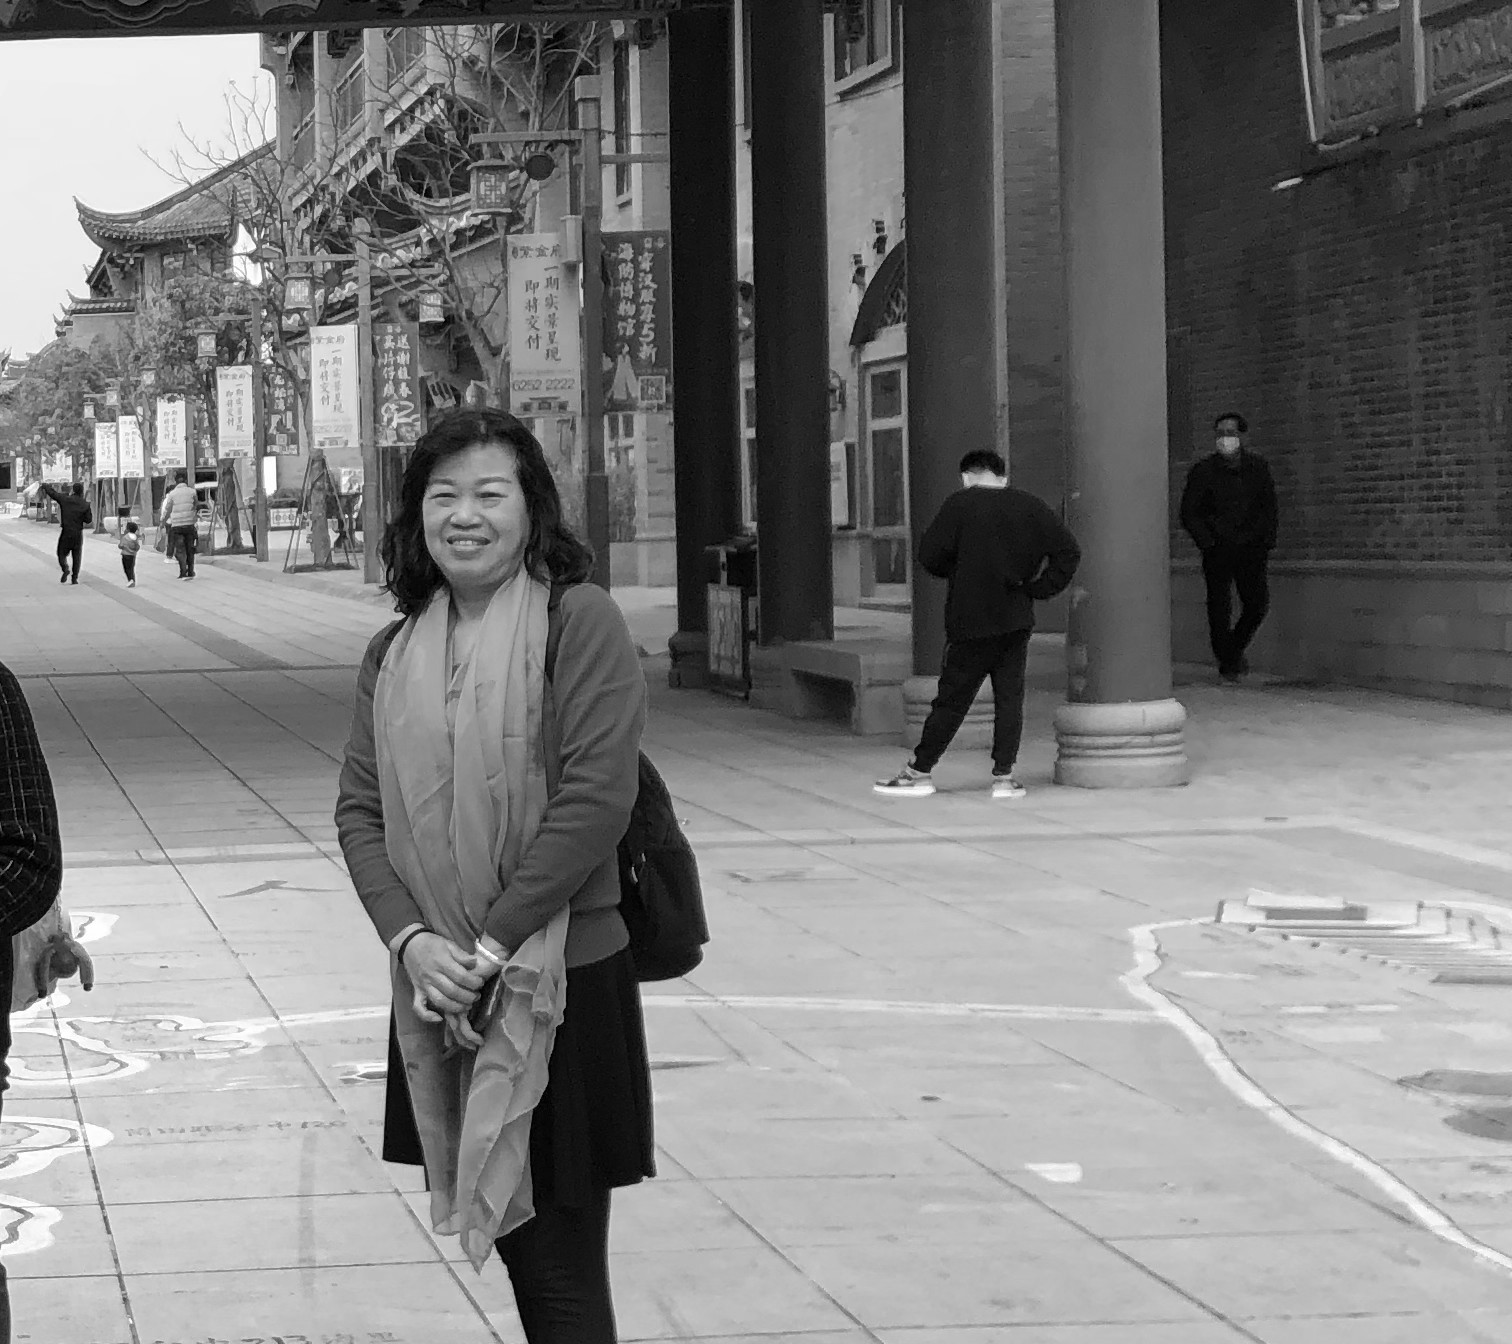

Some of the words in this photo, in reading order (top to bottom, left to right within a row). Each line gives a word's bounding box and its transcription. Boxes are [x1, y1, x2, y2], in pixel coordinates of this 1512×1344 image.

[525, 279, 542, 350] 即将交付
[543, 265, 562, 362] 一期实景呈现
[617, 242, 636, 337] 海防博物馆
[318, 358, 330, 406] 即将交付
[331, 348, 345, 414] 一期实景呈现
[545, 378, 576, 391] 2222
